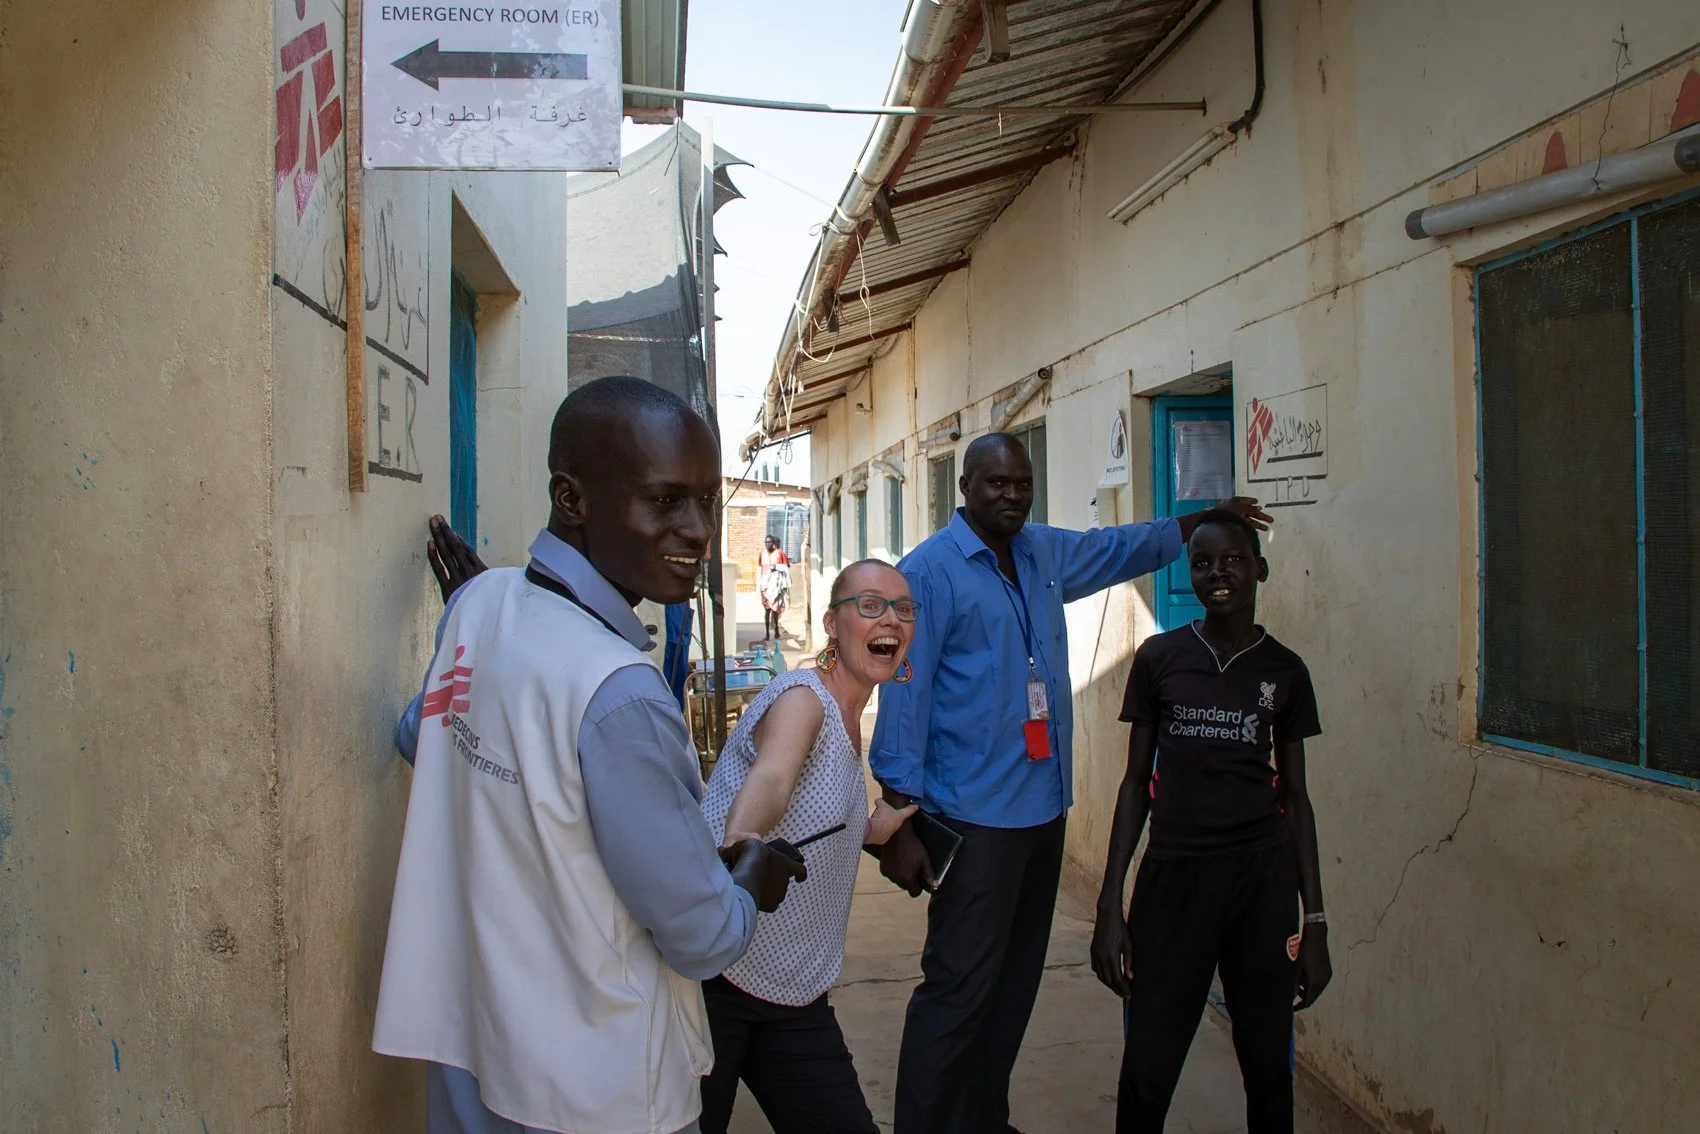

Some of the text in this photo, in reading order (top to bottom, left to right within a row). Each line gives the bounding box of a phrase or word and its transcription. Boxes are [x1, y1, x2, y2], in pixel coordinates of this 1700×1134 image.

[382, 6, 600, 27] EMERGENCY ROOM (ER)
[393, 105, 587, 128] غرفة الطوارئ
[1258, 697, 1274, 711] LFC
[1173, 705, 1242, 724] Standard
[1169, 721, 1240, 741] Chartered
[456, 739, 520, 785] FRONTIERES
